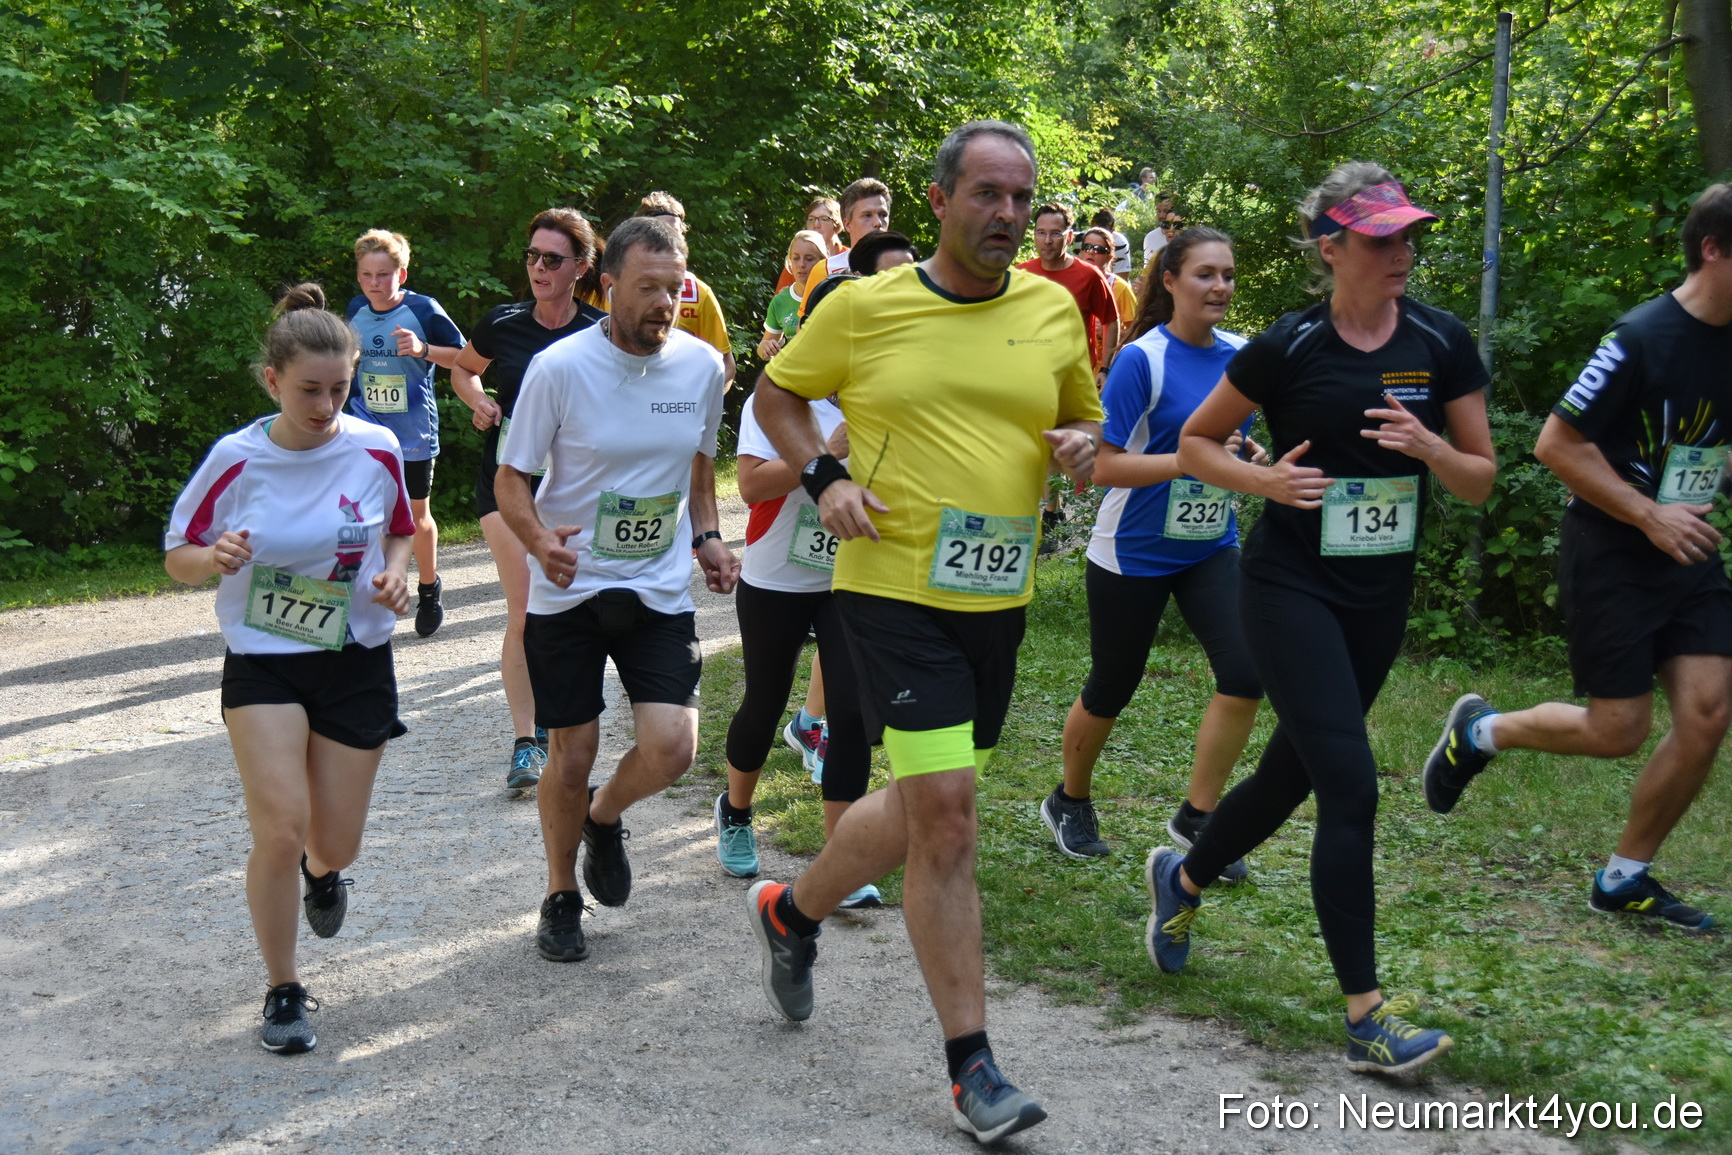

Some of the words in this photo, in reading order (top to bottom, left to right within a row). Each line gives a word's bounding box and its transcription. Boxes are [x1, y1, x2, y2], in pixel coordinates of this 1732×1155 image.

[1564, 338, 1625, 410] now
[366, 387, 400, 402] 2110
[651, 402, 697, 413] ROBERT
[1674, 468, 1718, 491] 1752
[1176, 500, 1226, 523] 2321
[1346, 505, 1398, 533] 134
[615, 518, 662, 542] 652
[638, 541, 658, 549] Robert
[810, 531, 841, 556] 36
[808, 552, 824, 561] Knör
[945, 540, 1021, 573] 2192
[955, 570, 988, 581] Miehling
[989, 573, 1008, 581] Franz
[262, 592, 336, 628] 1777
[326, 599, 345, 607] 2019
[275, 618, 293, 628] Beer
[294, 622, 314, 634] Anna
